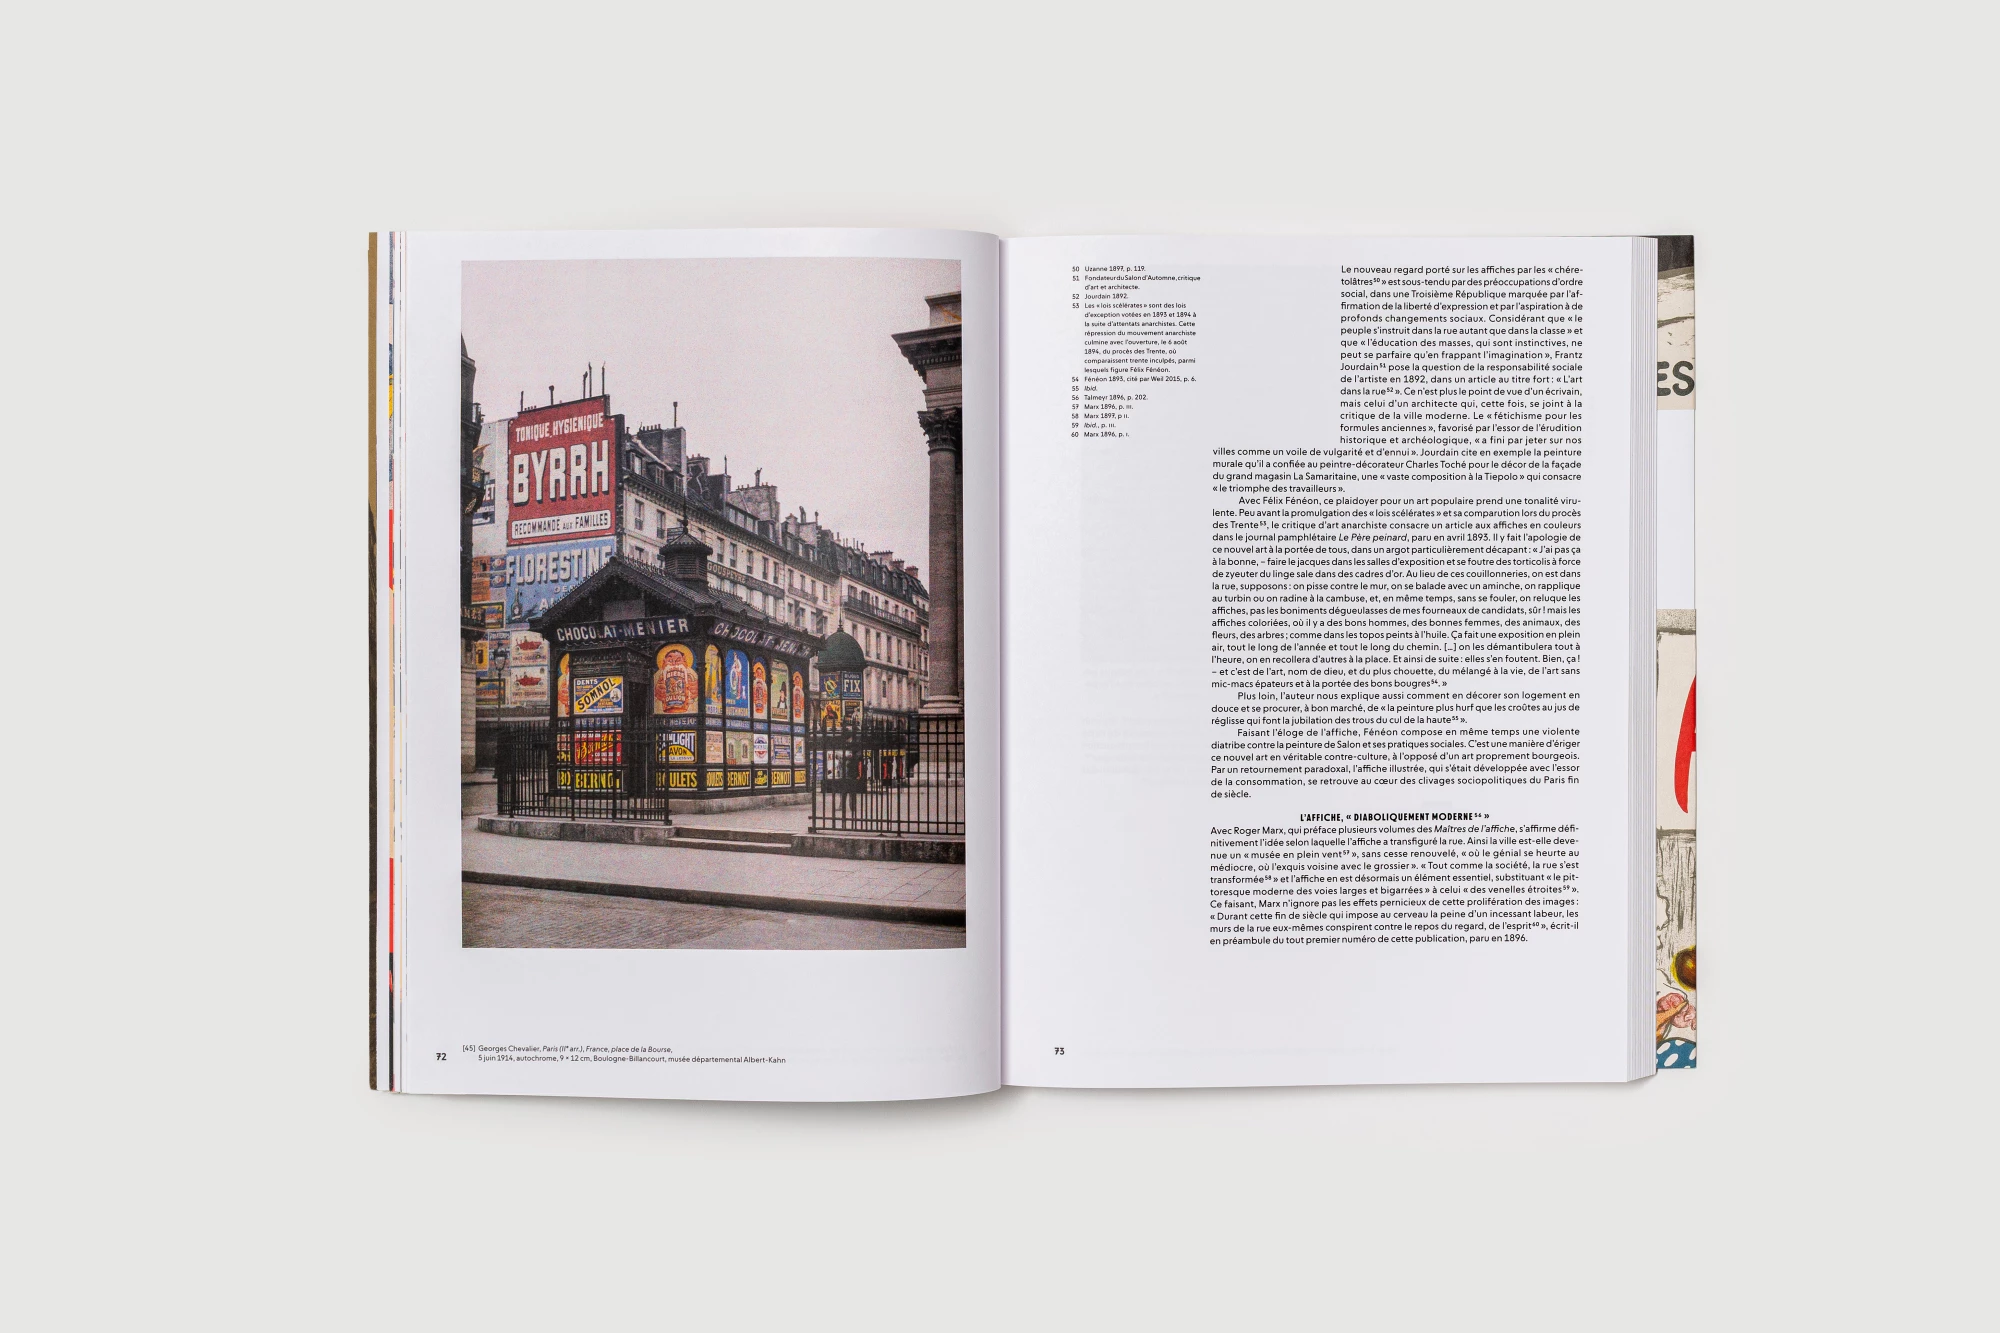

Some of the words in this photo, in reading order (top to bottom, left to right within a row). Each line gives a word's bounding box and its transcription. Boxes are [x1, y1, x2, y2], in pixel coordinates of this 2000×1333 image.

[1340, 289, 1368, 299] social,
[1369, 289, 1391, 298] dans
[1410, 289, 1454, 299] Troisième
[1455, 289, 1507, 300] République
[1508, 289, 1548, 300] marquée
[1549, 291, 1565, 300] par
[1340, 399, 1361, 408] mais
[1363, 399, 1386, 408] celui
[1411, 399, 1458, 408] architecte
[1460, 399, 1478, 410] qui,
[1507, 399, 1527, 409] fois,
[1542, 399, 1564, 410] joint
[1566, 399, 1572, 408] à
[1574, 399, 1583, 408] la
[513, 440, 608, 507] BYRRH
[1238, 496, 1261, 505] Avec
[1262, 496, 1284, 505] Félix
[1285, 496, 1322, 506] Fénéon,
[1335, 496, 1379, 507] plaidoyer
[1380, 498, 1402, 507] pour
[1430, 496, 1474, 507] populaire
[1476, 496, 1504, 507] prend
[1524, 496, 1559, 505] tonalité
[575, 512, 608, 529] FAMILLES
[844, 680, 860, 692] FIX
[578, 678, 616, 710] SOMNOL
[1353, 812, 1430, 823] DIABOLIQUEMENT
[1222, 936, 1271, 947] préambule
[1272, 935, 1284, 945] du
[1286, 936, 1304, 944] tout
[1306, 935, 1341, 946] premier
[1341, 934, 1376, 944] numéro
[1377, 934, 1390, 943] de
[1415, 933, 1468, 945] publication,
[1469, 935, 1490, 944] paru
[1504, 933, 1528, 942] 1896.
[462, 1044, 476, 1053] [45]
[478, 1044, 507, 1055] Georges
[508, 1045, 542, 1053] Chevalier,
[610, 1046, 630, 1054] place
[648, 1045, 673, 1054] Bourse,
[1054, 1047, 1065, 1056] 73
[436, 1052, 447, 1061] 72
[483, 1054, 496, 1063] juin
[593, 1054, 667, 1064] Boulogne-Billancourt,
[691, 1055, 743, 1064] départemental
